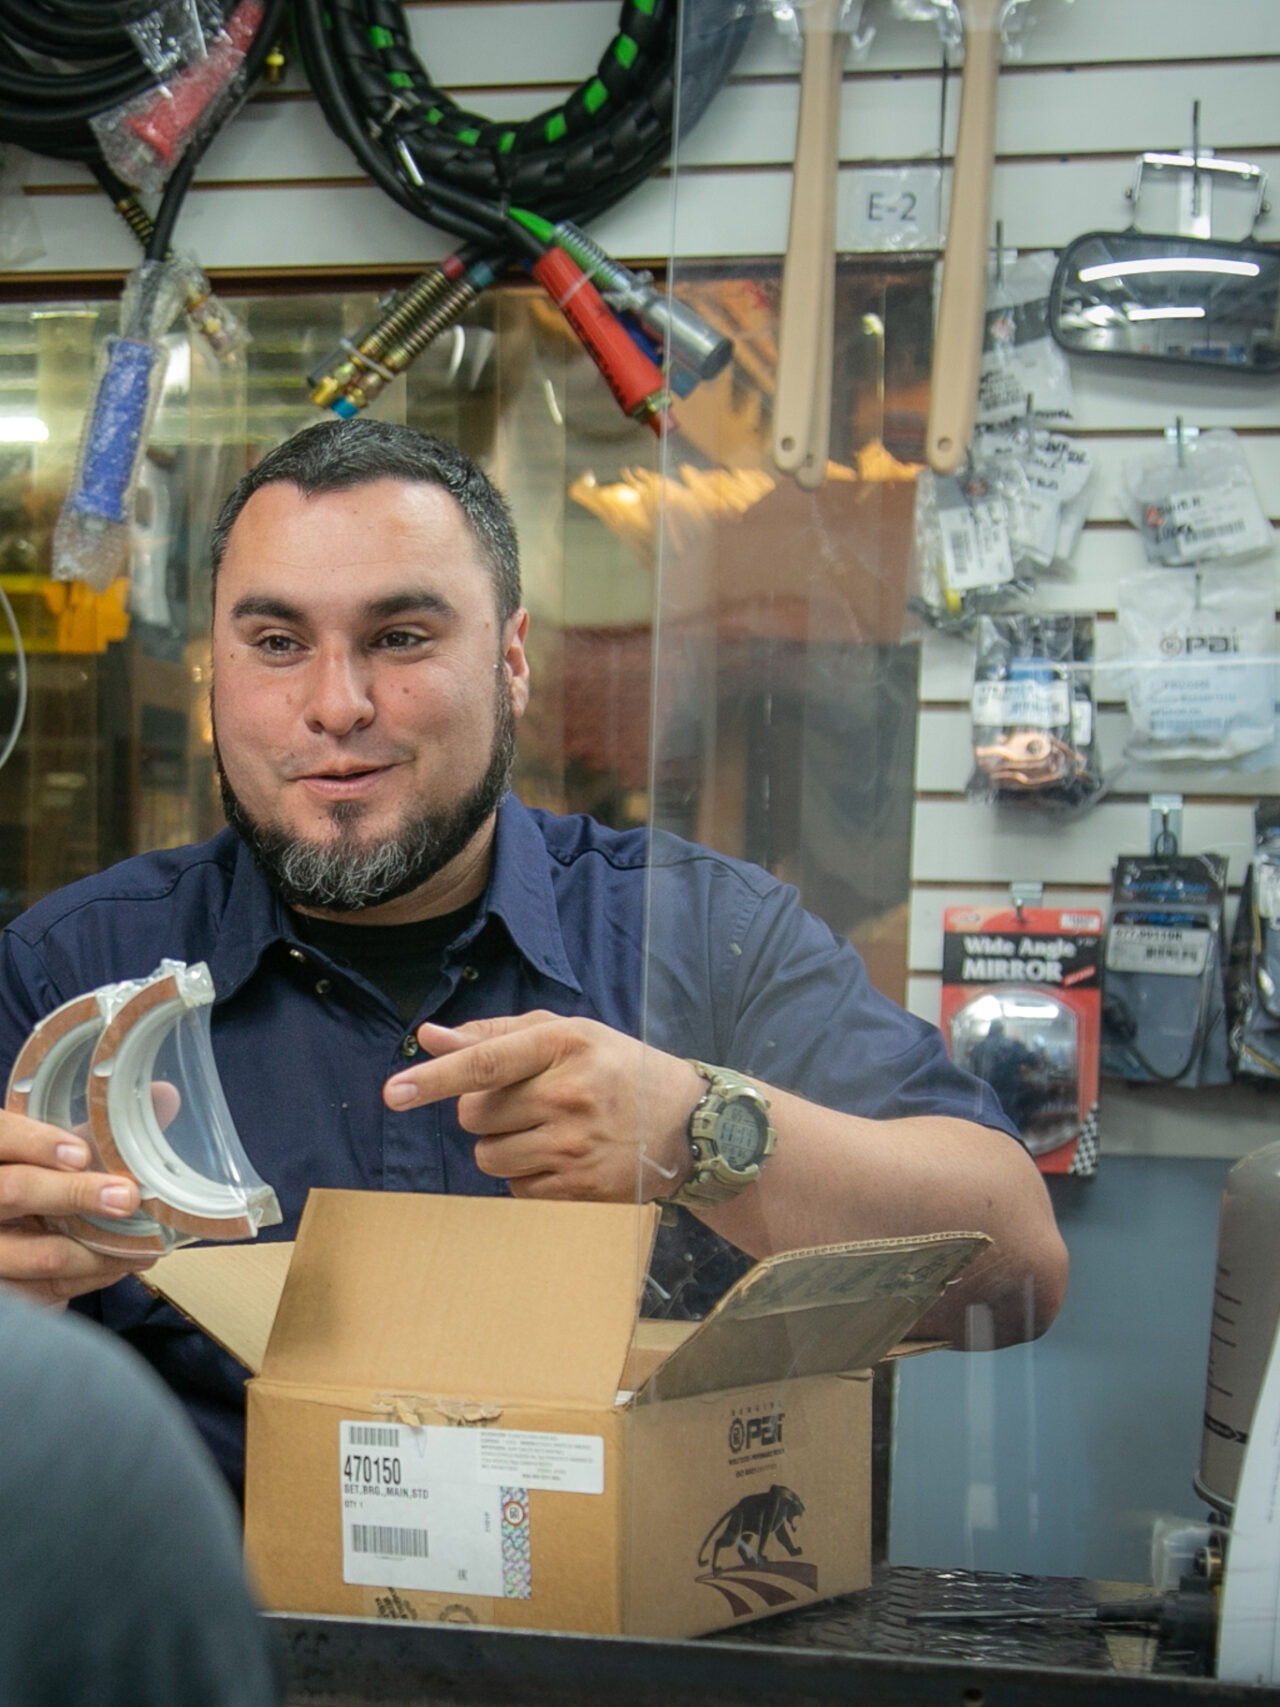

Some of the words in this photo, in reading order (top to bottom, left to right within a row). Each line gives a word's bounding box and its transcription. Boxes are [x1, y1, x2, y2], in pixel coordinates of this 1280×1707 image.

[868, 192, 917, 221] E-2
[963, 935, 1016, 956] Wide
[1018, 936, 1077, 961] Angle
[962, 957, 1063, 983] MIRROR
[343, 1455, 402, 1486] 470150
